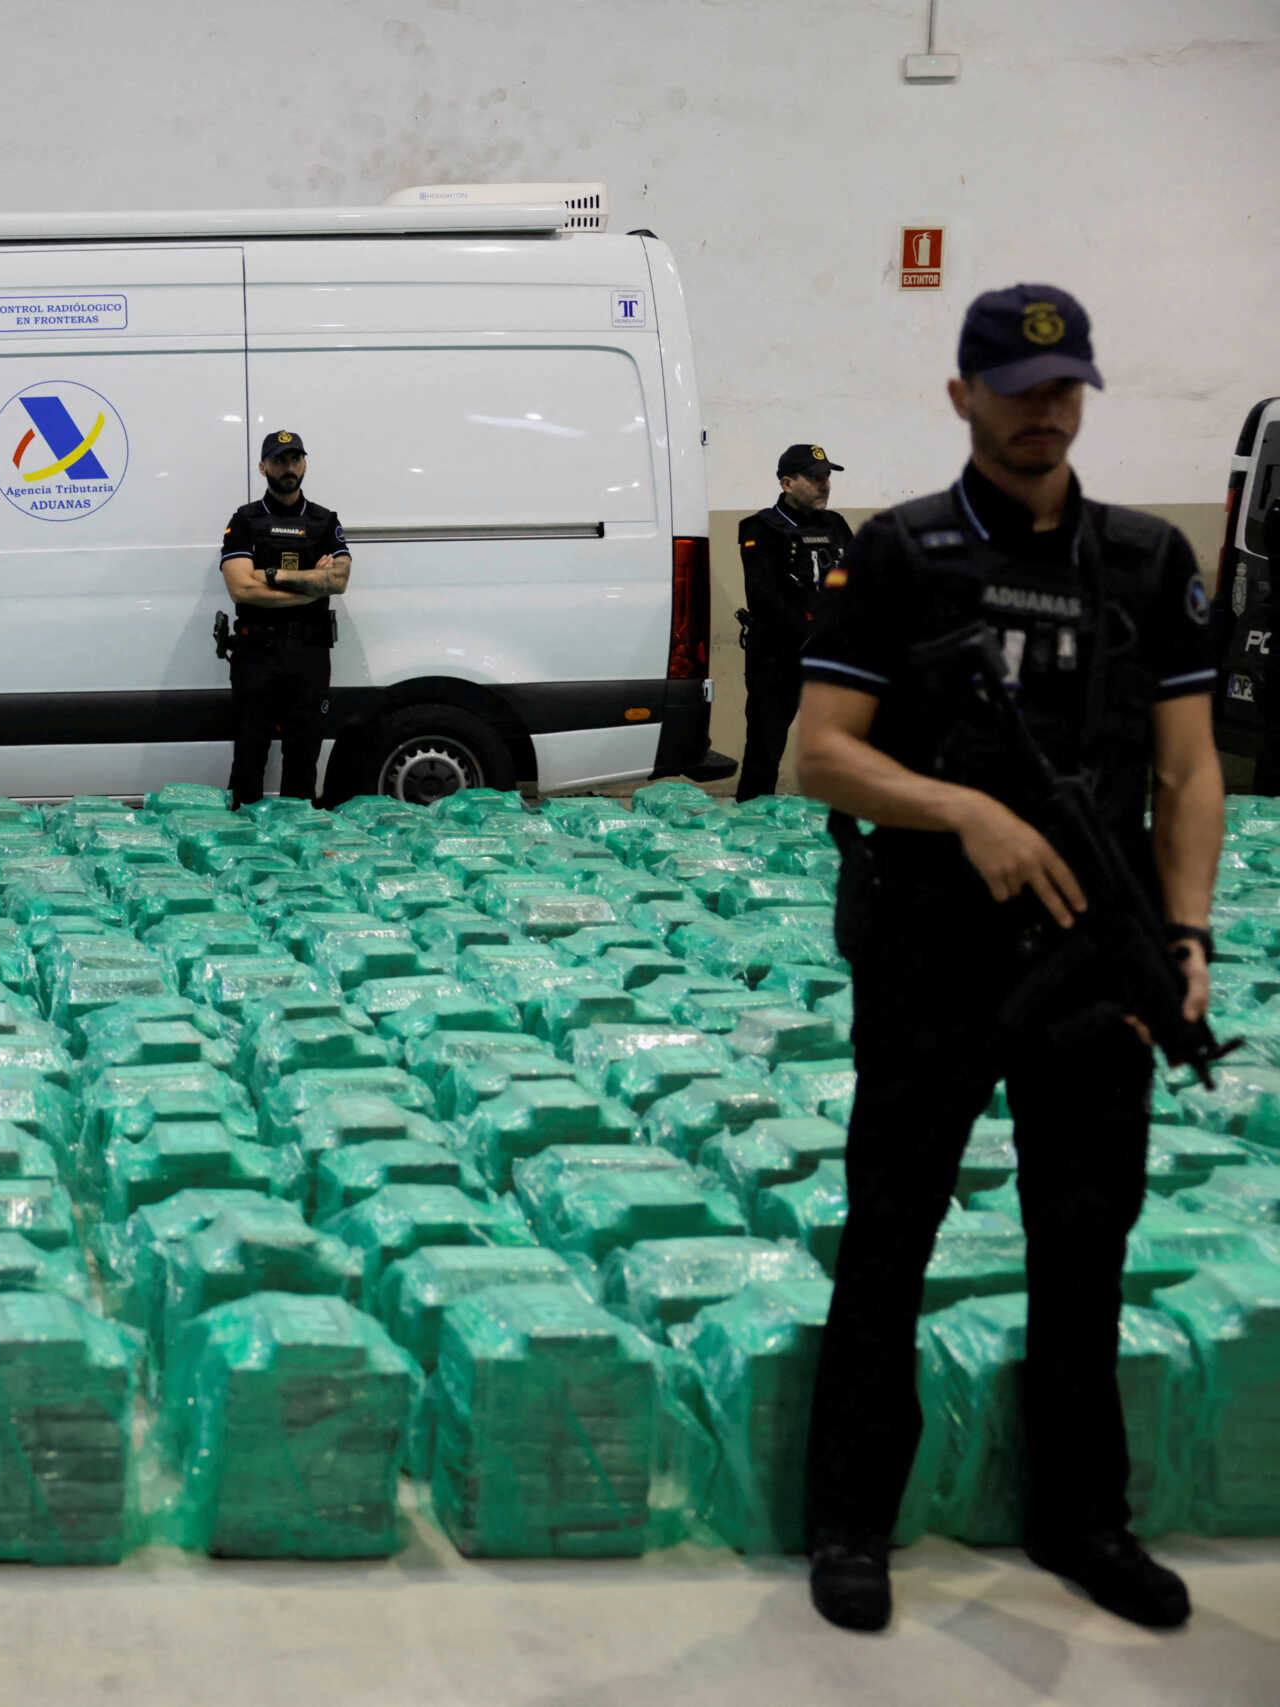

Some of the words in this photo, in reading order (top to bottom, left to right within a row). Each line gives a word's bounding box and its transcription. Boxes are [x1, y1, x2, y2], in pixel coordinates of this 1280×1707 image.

[903, 275, 938, 285] EXTINTOR
[16, 317, 30, 325] EN
[34, 315, 99, 325] FRONTERAS
[6, 485, 52, 498] Agencia
[55, 483, 114, 494] Tributaria
[30, 499, 91, 511] ADUANAS
[982, 585, 1081, 617] ADUANAS
